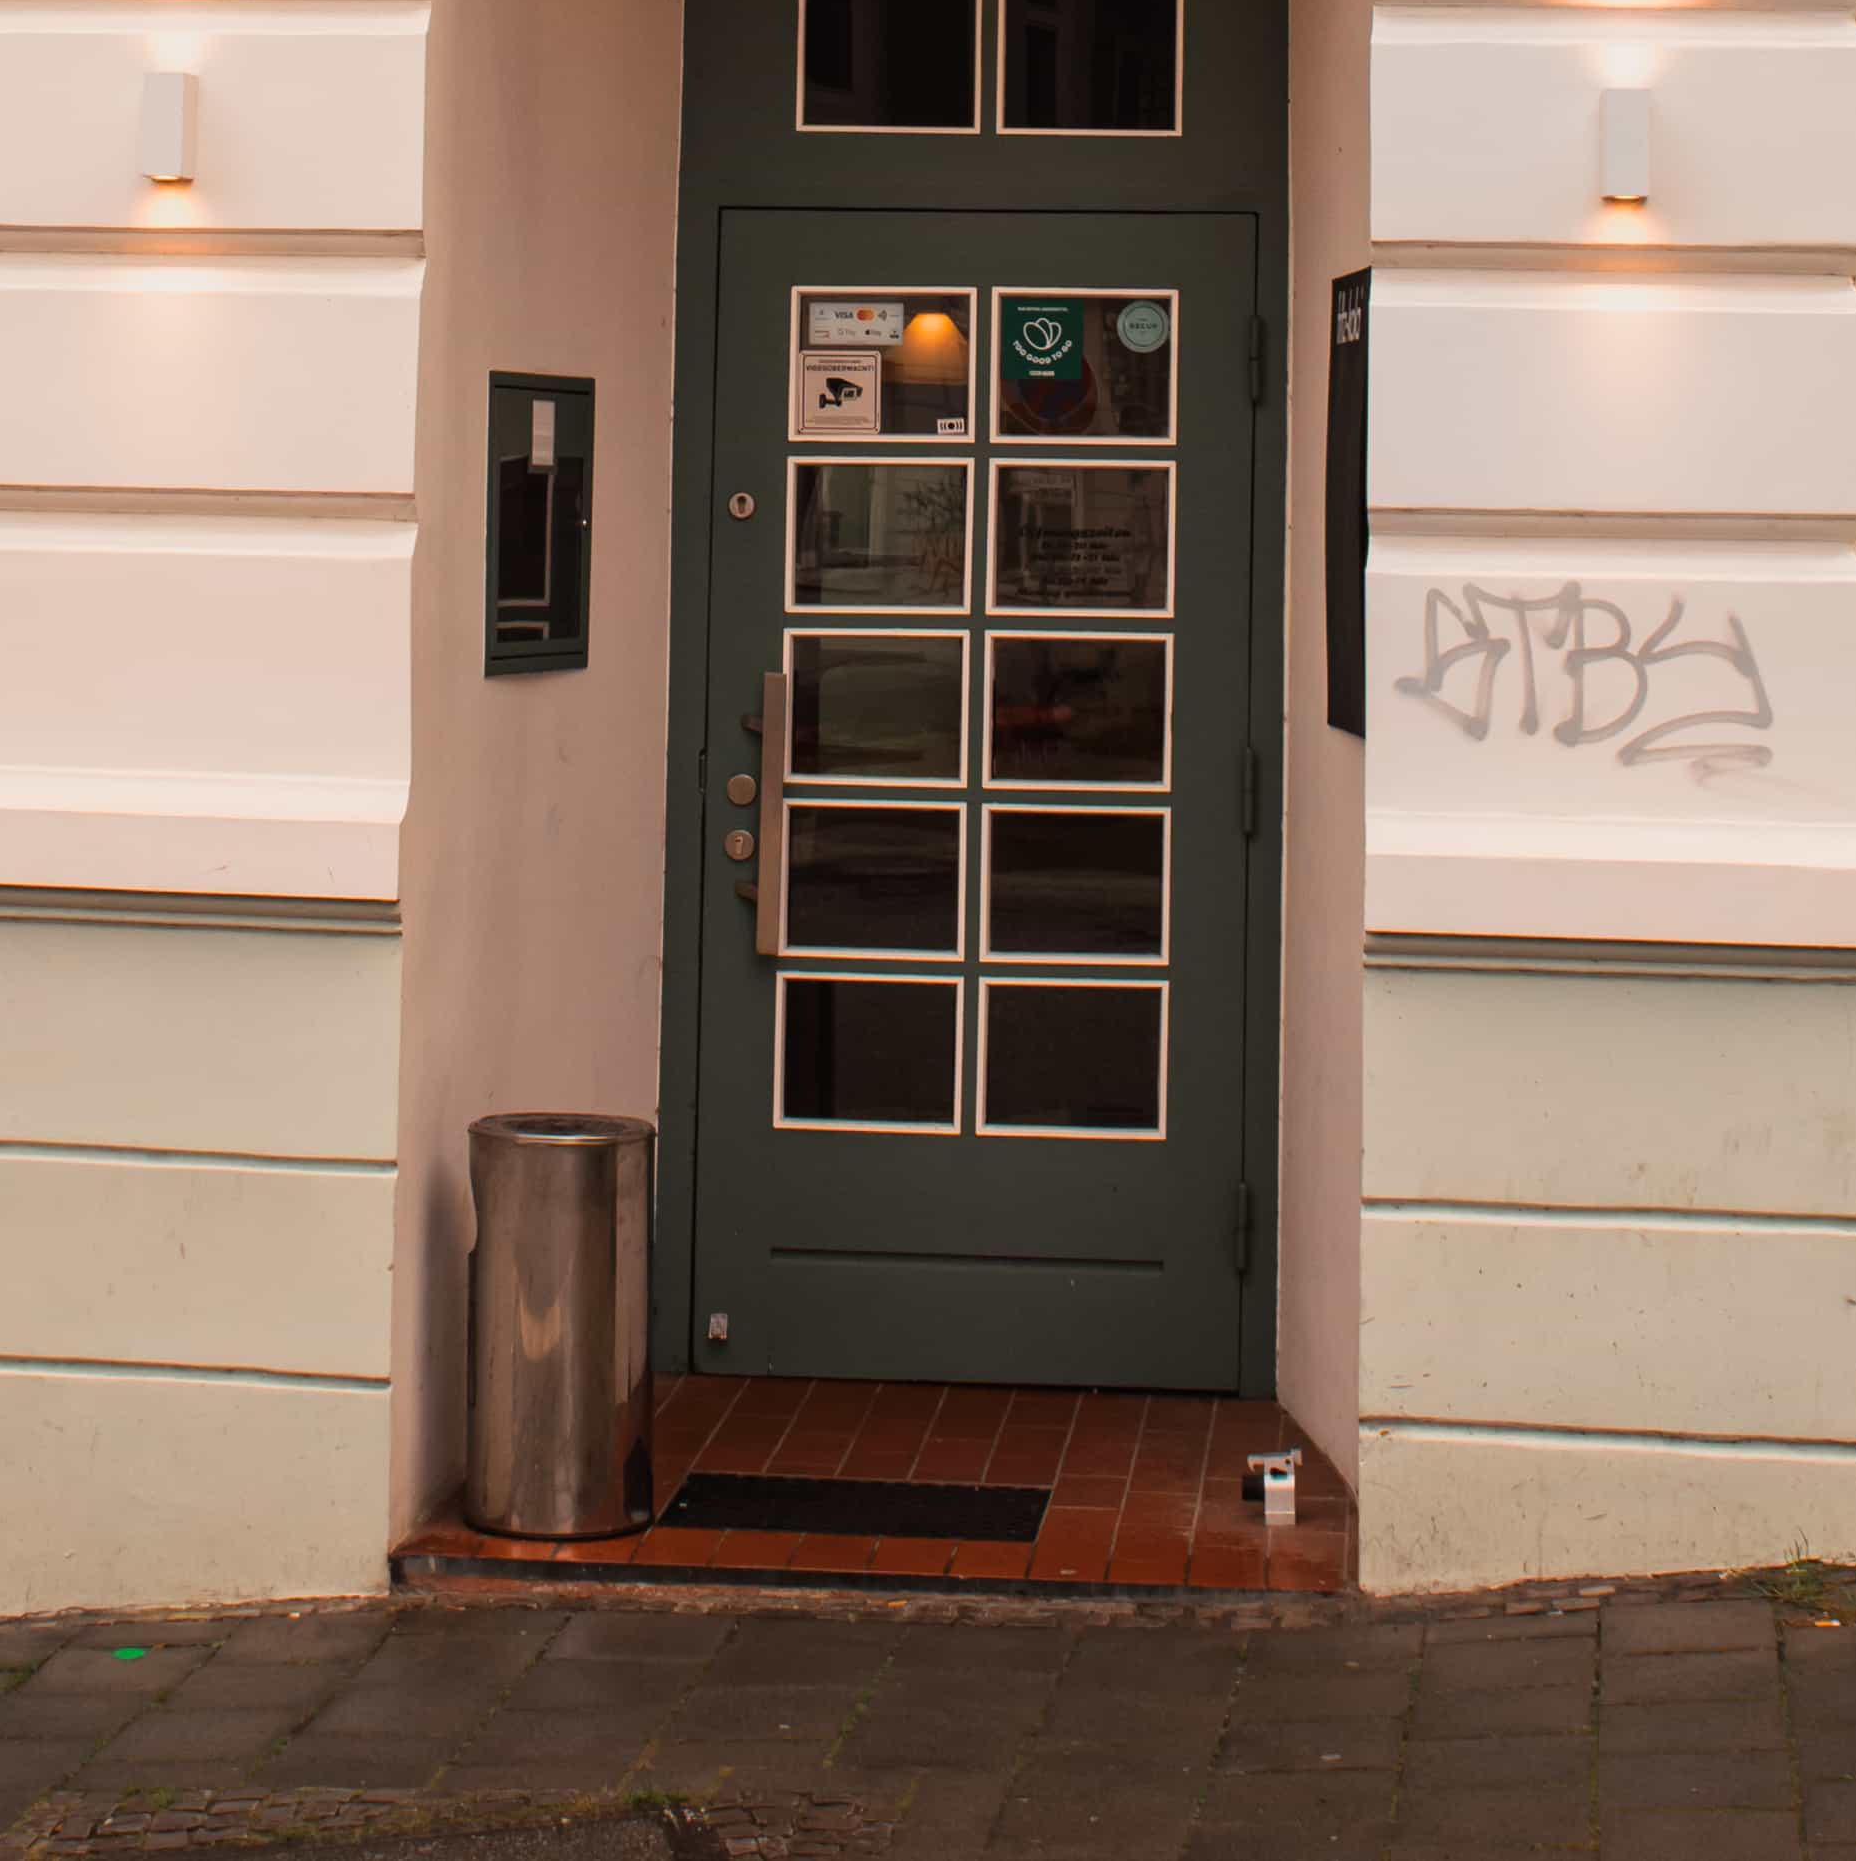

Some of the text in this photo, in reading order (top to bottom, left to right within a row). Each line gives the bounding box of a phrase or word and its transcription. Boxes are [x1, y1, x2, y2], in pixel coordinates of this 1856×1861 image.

[833, 310, 854, 320] VISA
[1013, 340, 1028, 355] TOO
[1026, 354, 1052, 365] GOOD
[1051, 351, 1063, 361] TO
